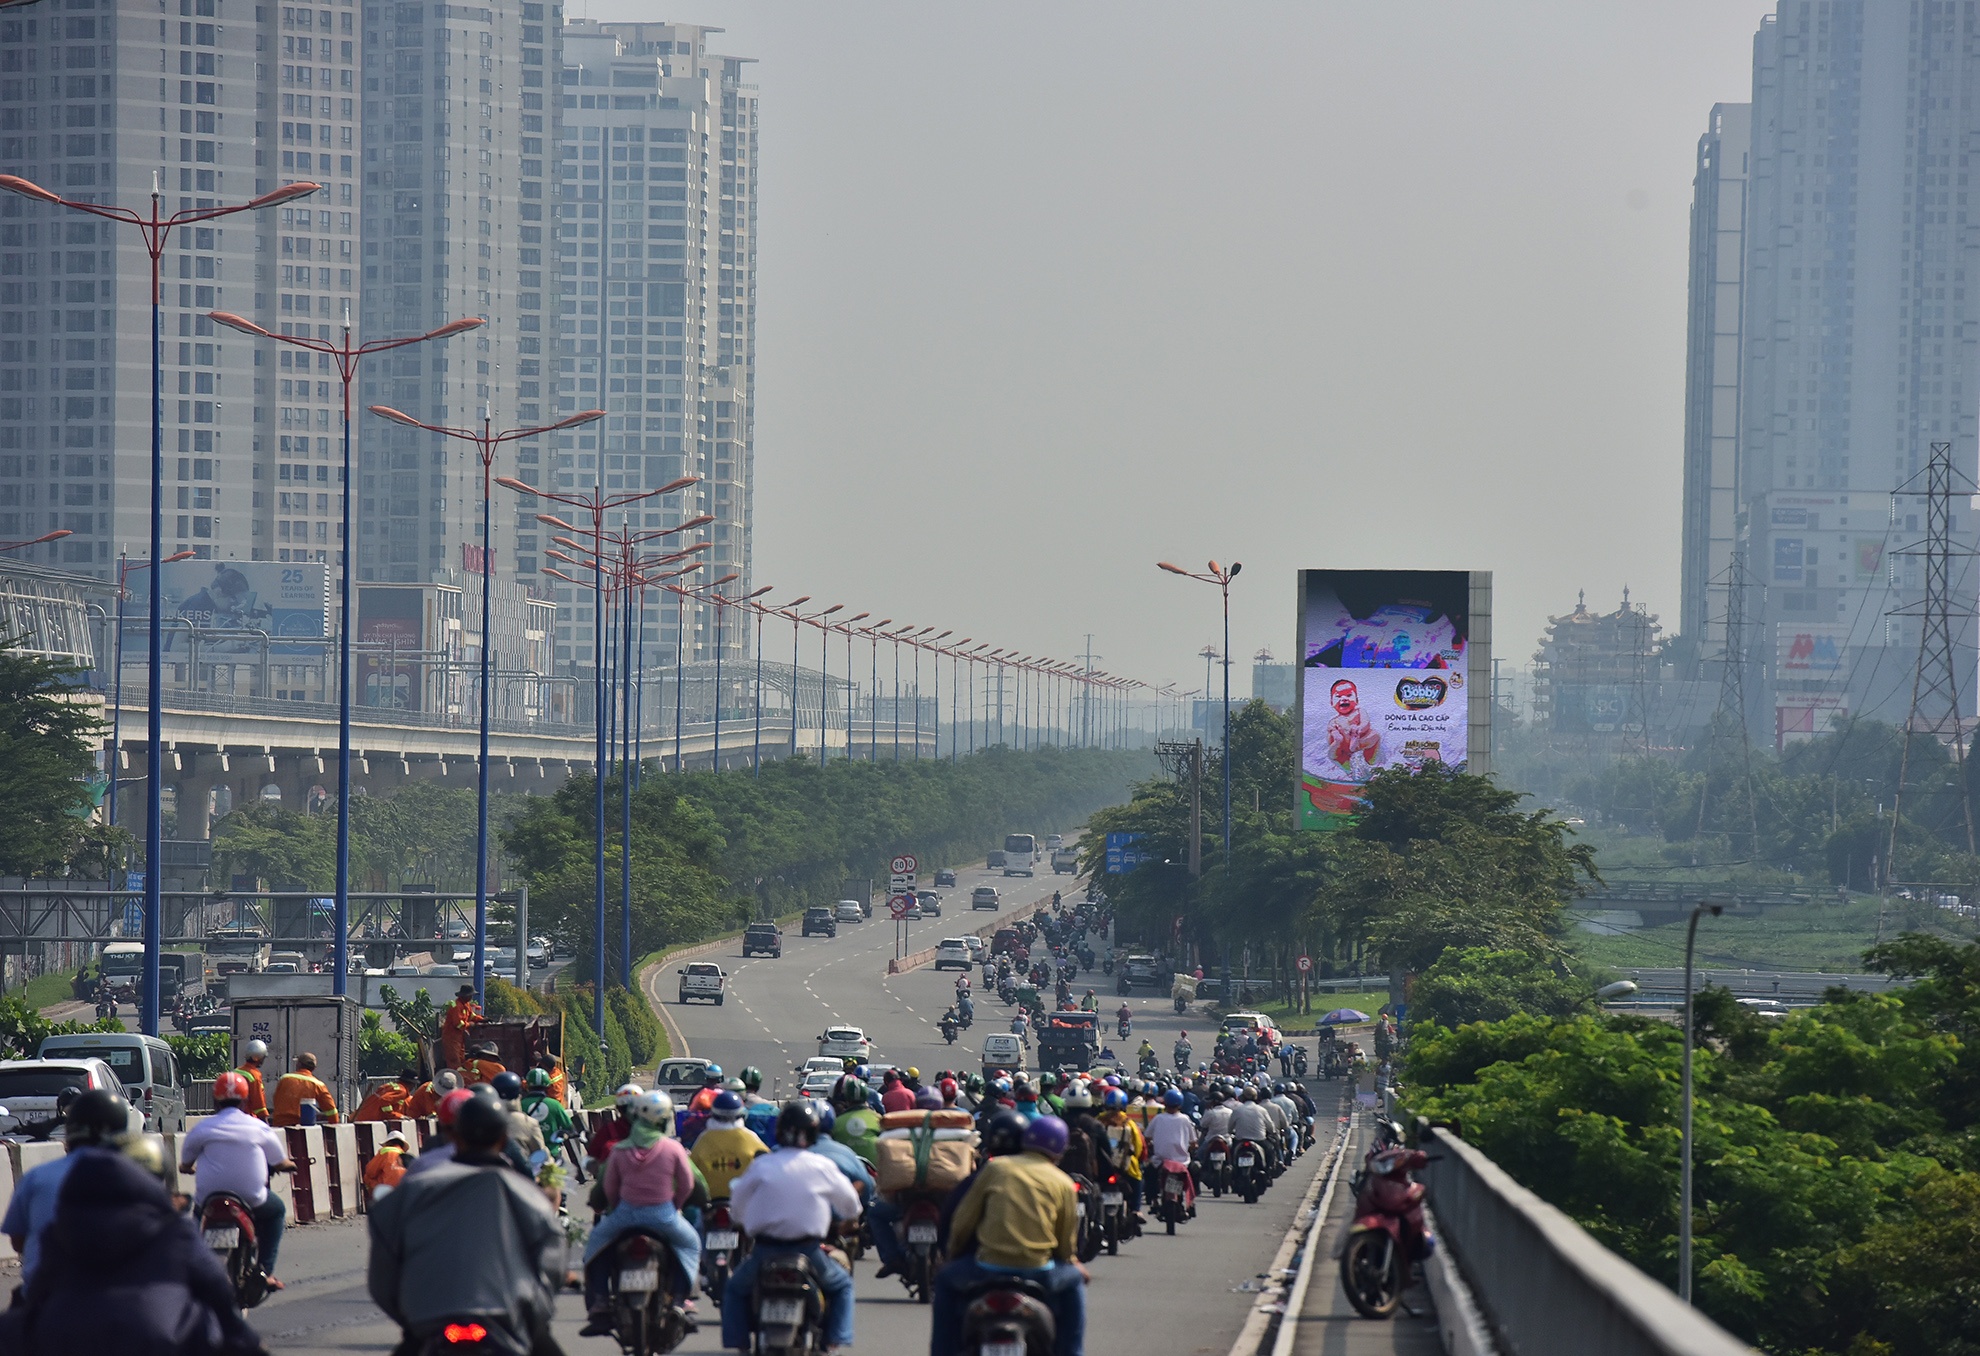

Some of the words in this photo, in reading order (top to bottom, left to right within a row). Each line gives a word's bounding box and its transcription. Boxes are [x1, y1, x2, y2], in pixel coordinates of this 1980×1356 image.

[281, 569, 303, 583] 25
[1402, 684, 1439, 700] Bobby
[895, 861, 904, 869] 80
[252, 1022, 270, 1032] 54Z
